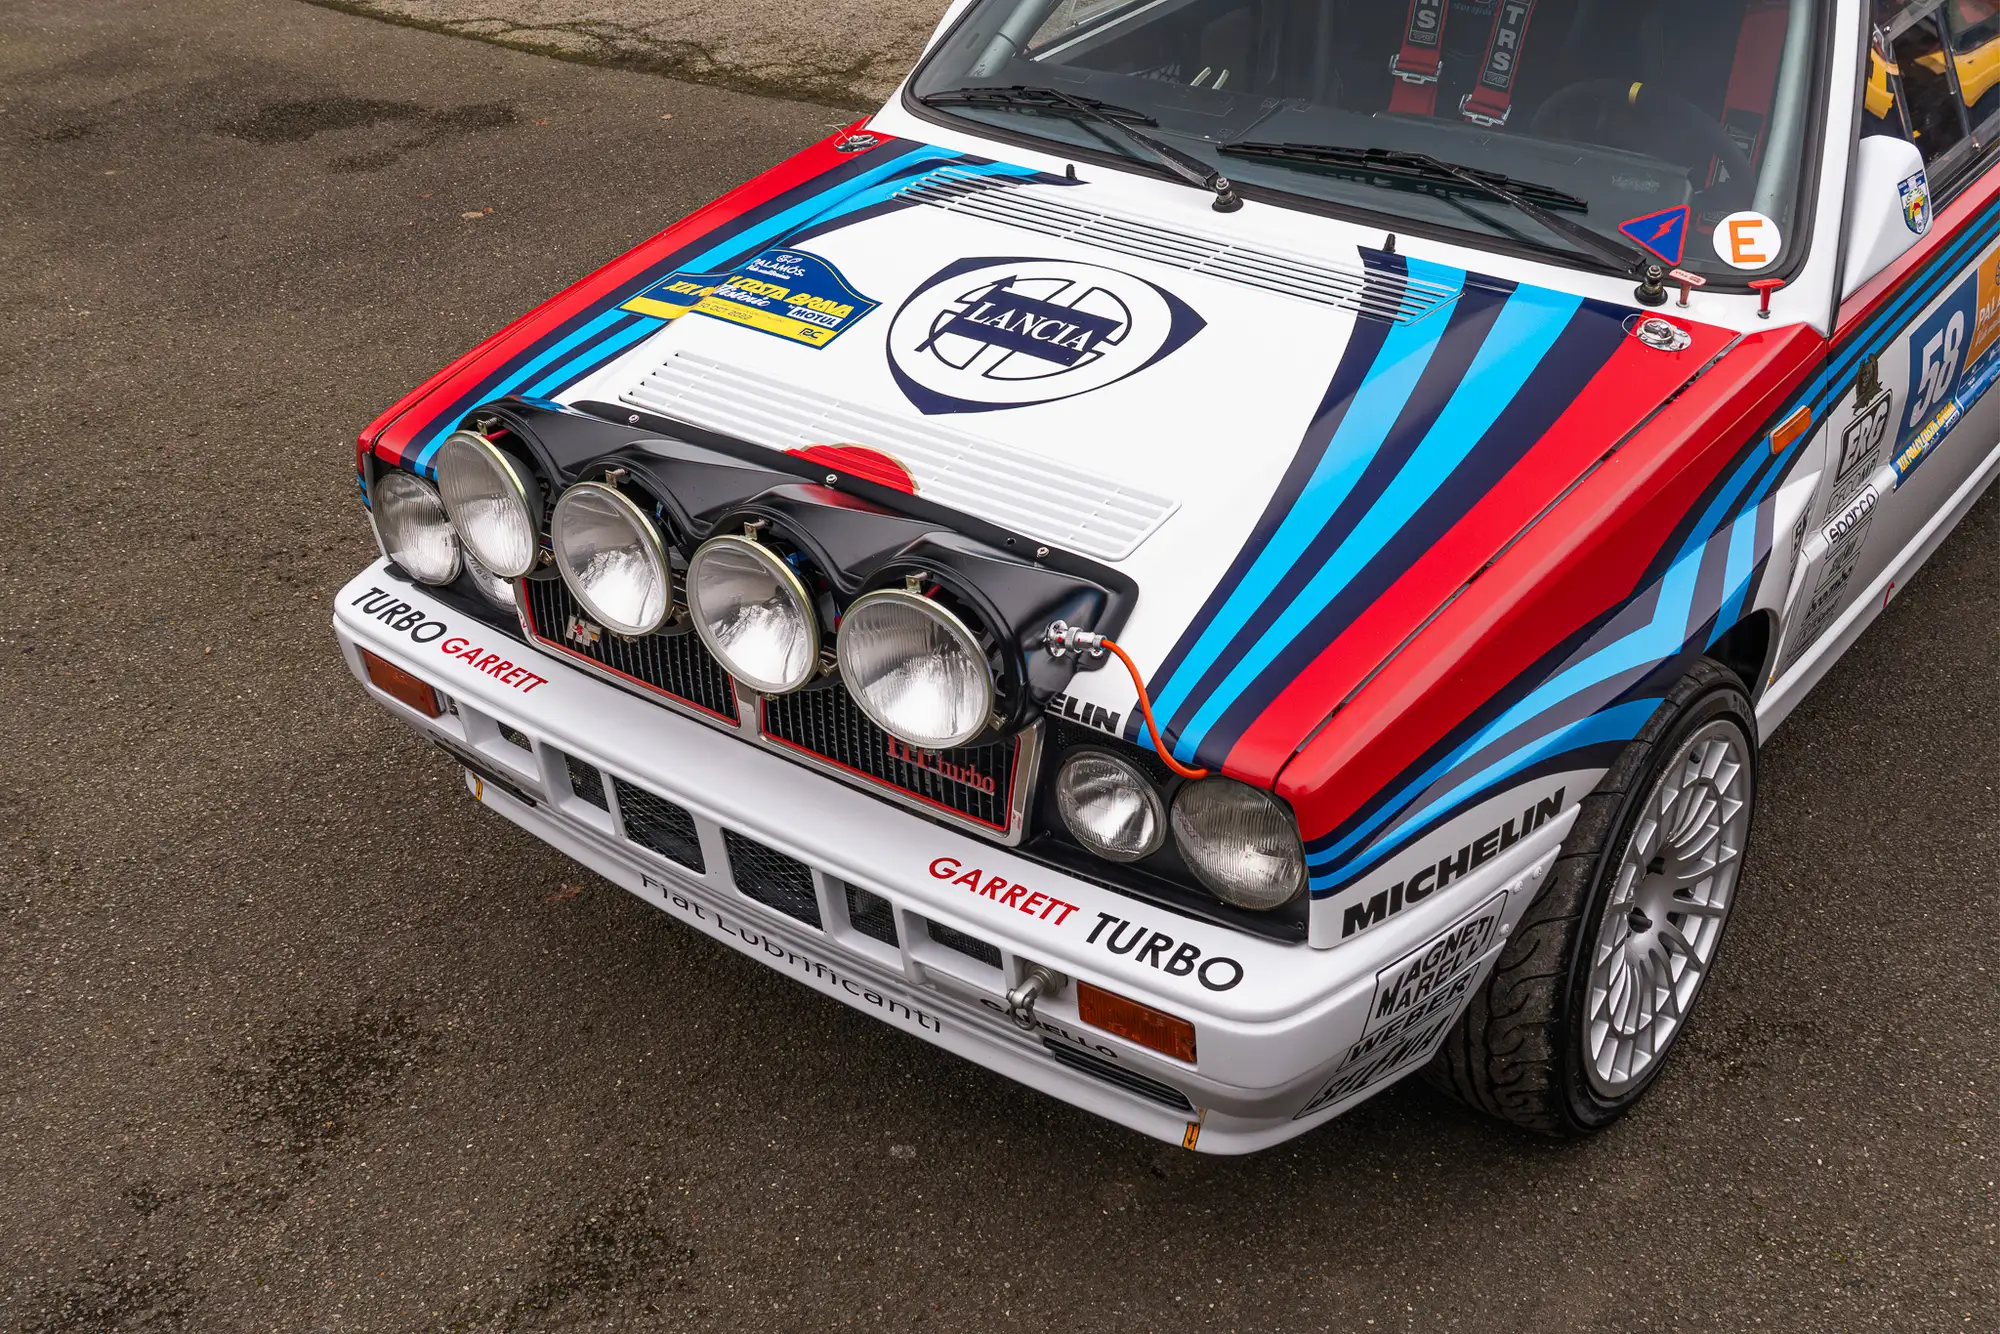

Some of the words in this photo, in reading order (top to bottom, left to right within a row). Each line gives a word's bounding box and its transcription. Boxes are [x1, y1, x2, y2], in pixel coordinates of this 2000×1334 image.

[1416, 0, 1438, 29] S
[1492, 5, 1525, 72] TRS
[1729, 220, 1766, 263] E
[783, 292, 855, 318] BRAVA
[791, 308, 837, 326] MOTUL
[964, 300, 1094, 352] LANCIA
[1909, 310, 1964, 428] 58
[1829, 493, 1876, 545] sparco
[351, 587, 448, 643] TURBO
[440, 636, 549, 694] GARRETT
[938, 751, 996, 793] turbo
[1341, 786, 1566, 939] MICHELIN
[928, 856, 1080, 927] GARRETT
[1085, 912, 1244, 992] TURBO
[640, 874, 706, 921] Fiat
[716, 912, 942, 1034] Lubrificanti
[1349, 973, 1471, 1063] WEBER
